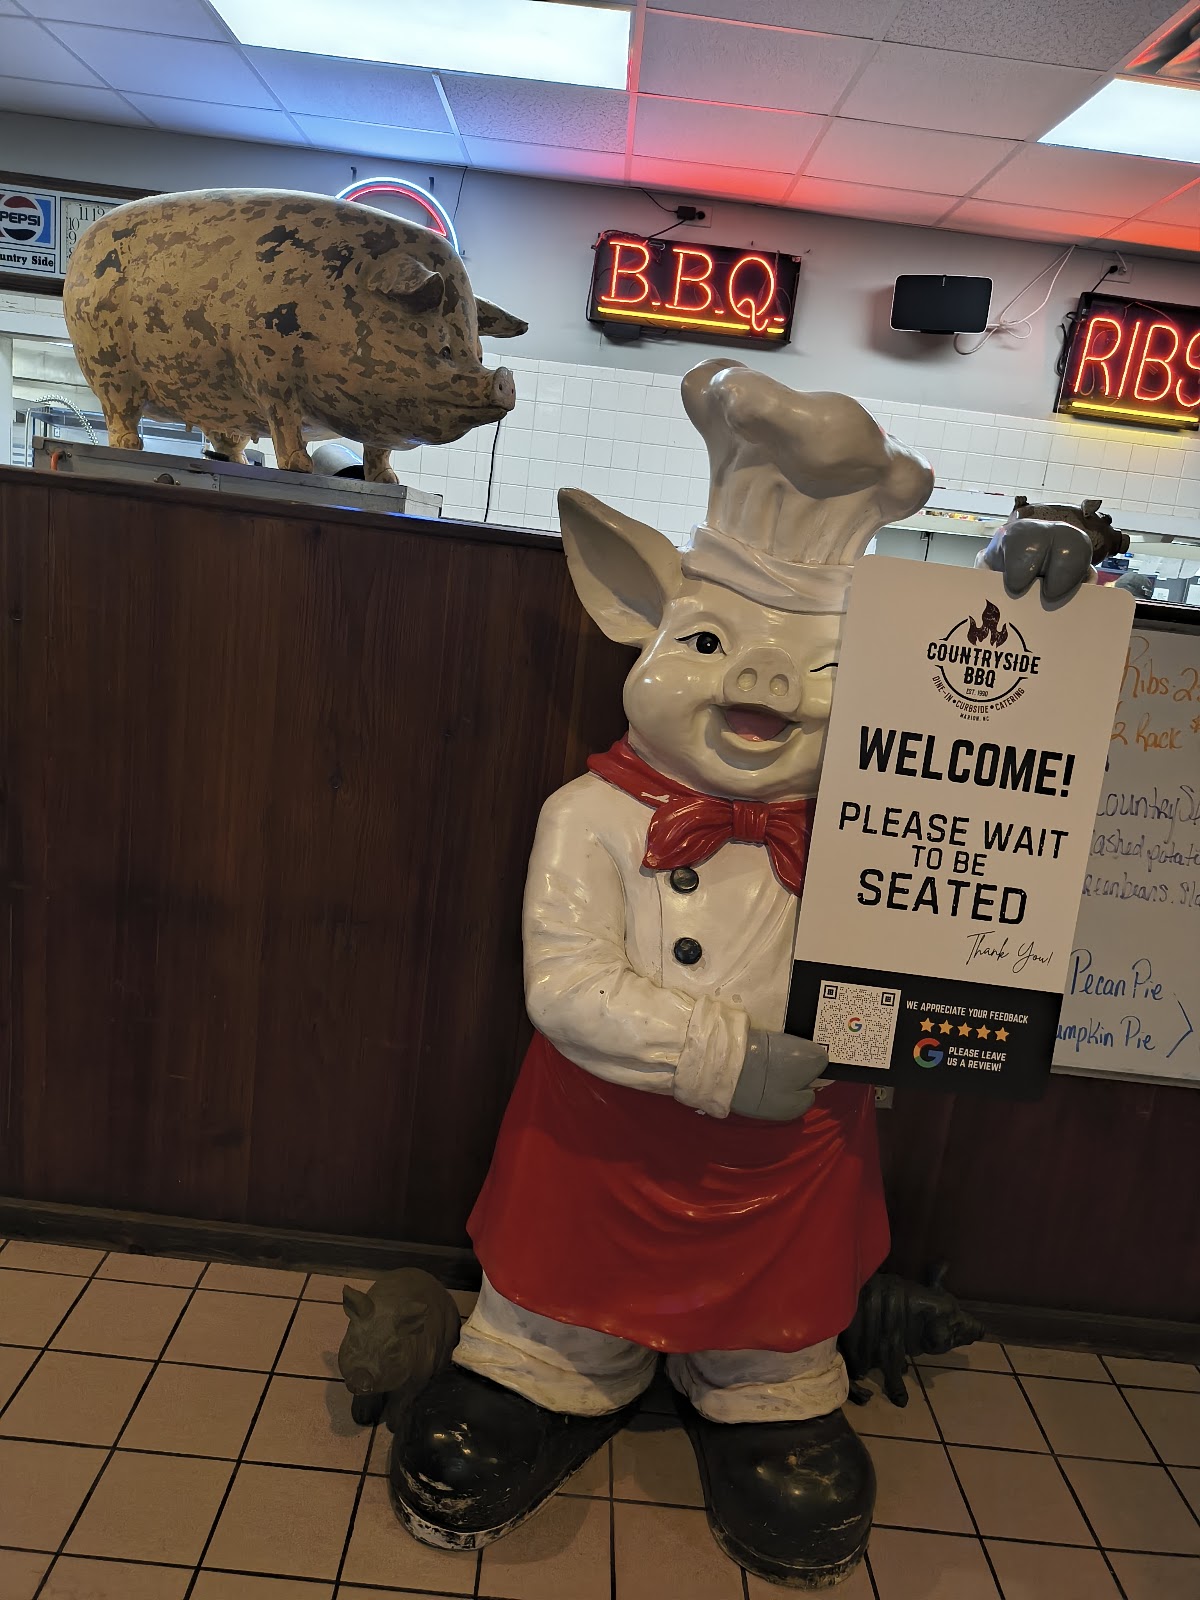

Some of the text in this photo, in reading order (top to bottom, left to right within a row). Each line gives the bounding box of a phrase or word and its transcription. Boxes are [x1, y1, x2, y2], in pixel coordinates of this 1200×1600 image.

[0, 211, 40, 226] PEPSI
[68, 217, 80, 231] 10
[32, 256, 54, 267] Side
[1074, 317, 1200, 407] RIBS
[927, 642, 1041, 675] COUNTRYSIDE
[963, 666, 996, 688] BBQ
[932, 675, 1025, 713] DINE-IN CURBSIDE CATERING
[859, 725, 1076, 798] WELCOME!
[839, 801, 1069, 859] PLEASE WAIT
[1096, 787, 1180, 844] ountry
[1090, 829, 1145, 857] ashed
[911, 844, 987, 877] TO BE
[857, 868, 1027, 925] SEATED
[966, 930, 1054, 974] Thank You!
[1070, 949, 1164, 1000] Pecan Pie
[906, 1000, 1029, 1024] WE APPRECIATE YOUR FEEDBACK
[1120, 1015, 1155, 1050] Pie
[947, 1057, 1002, 1072] US A REVIEW!
[948, 1046, 1006, 1062] PLEASE LEAVE
